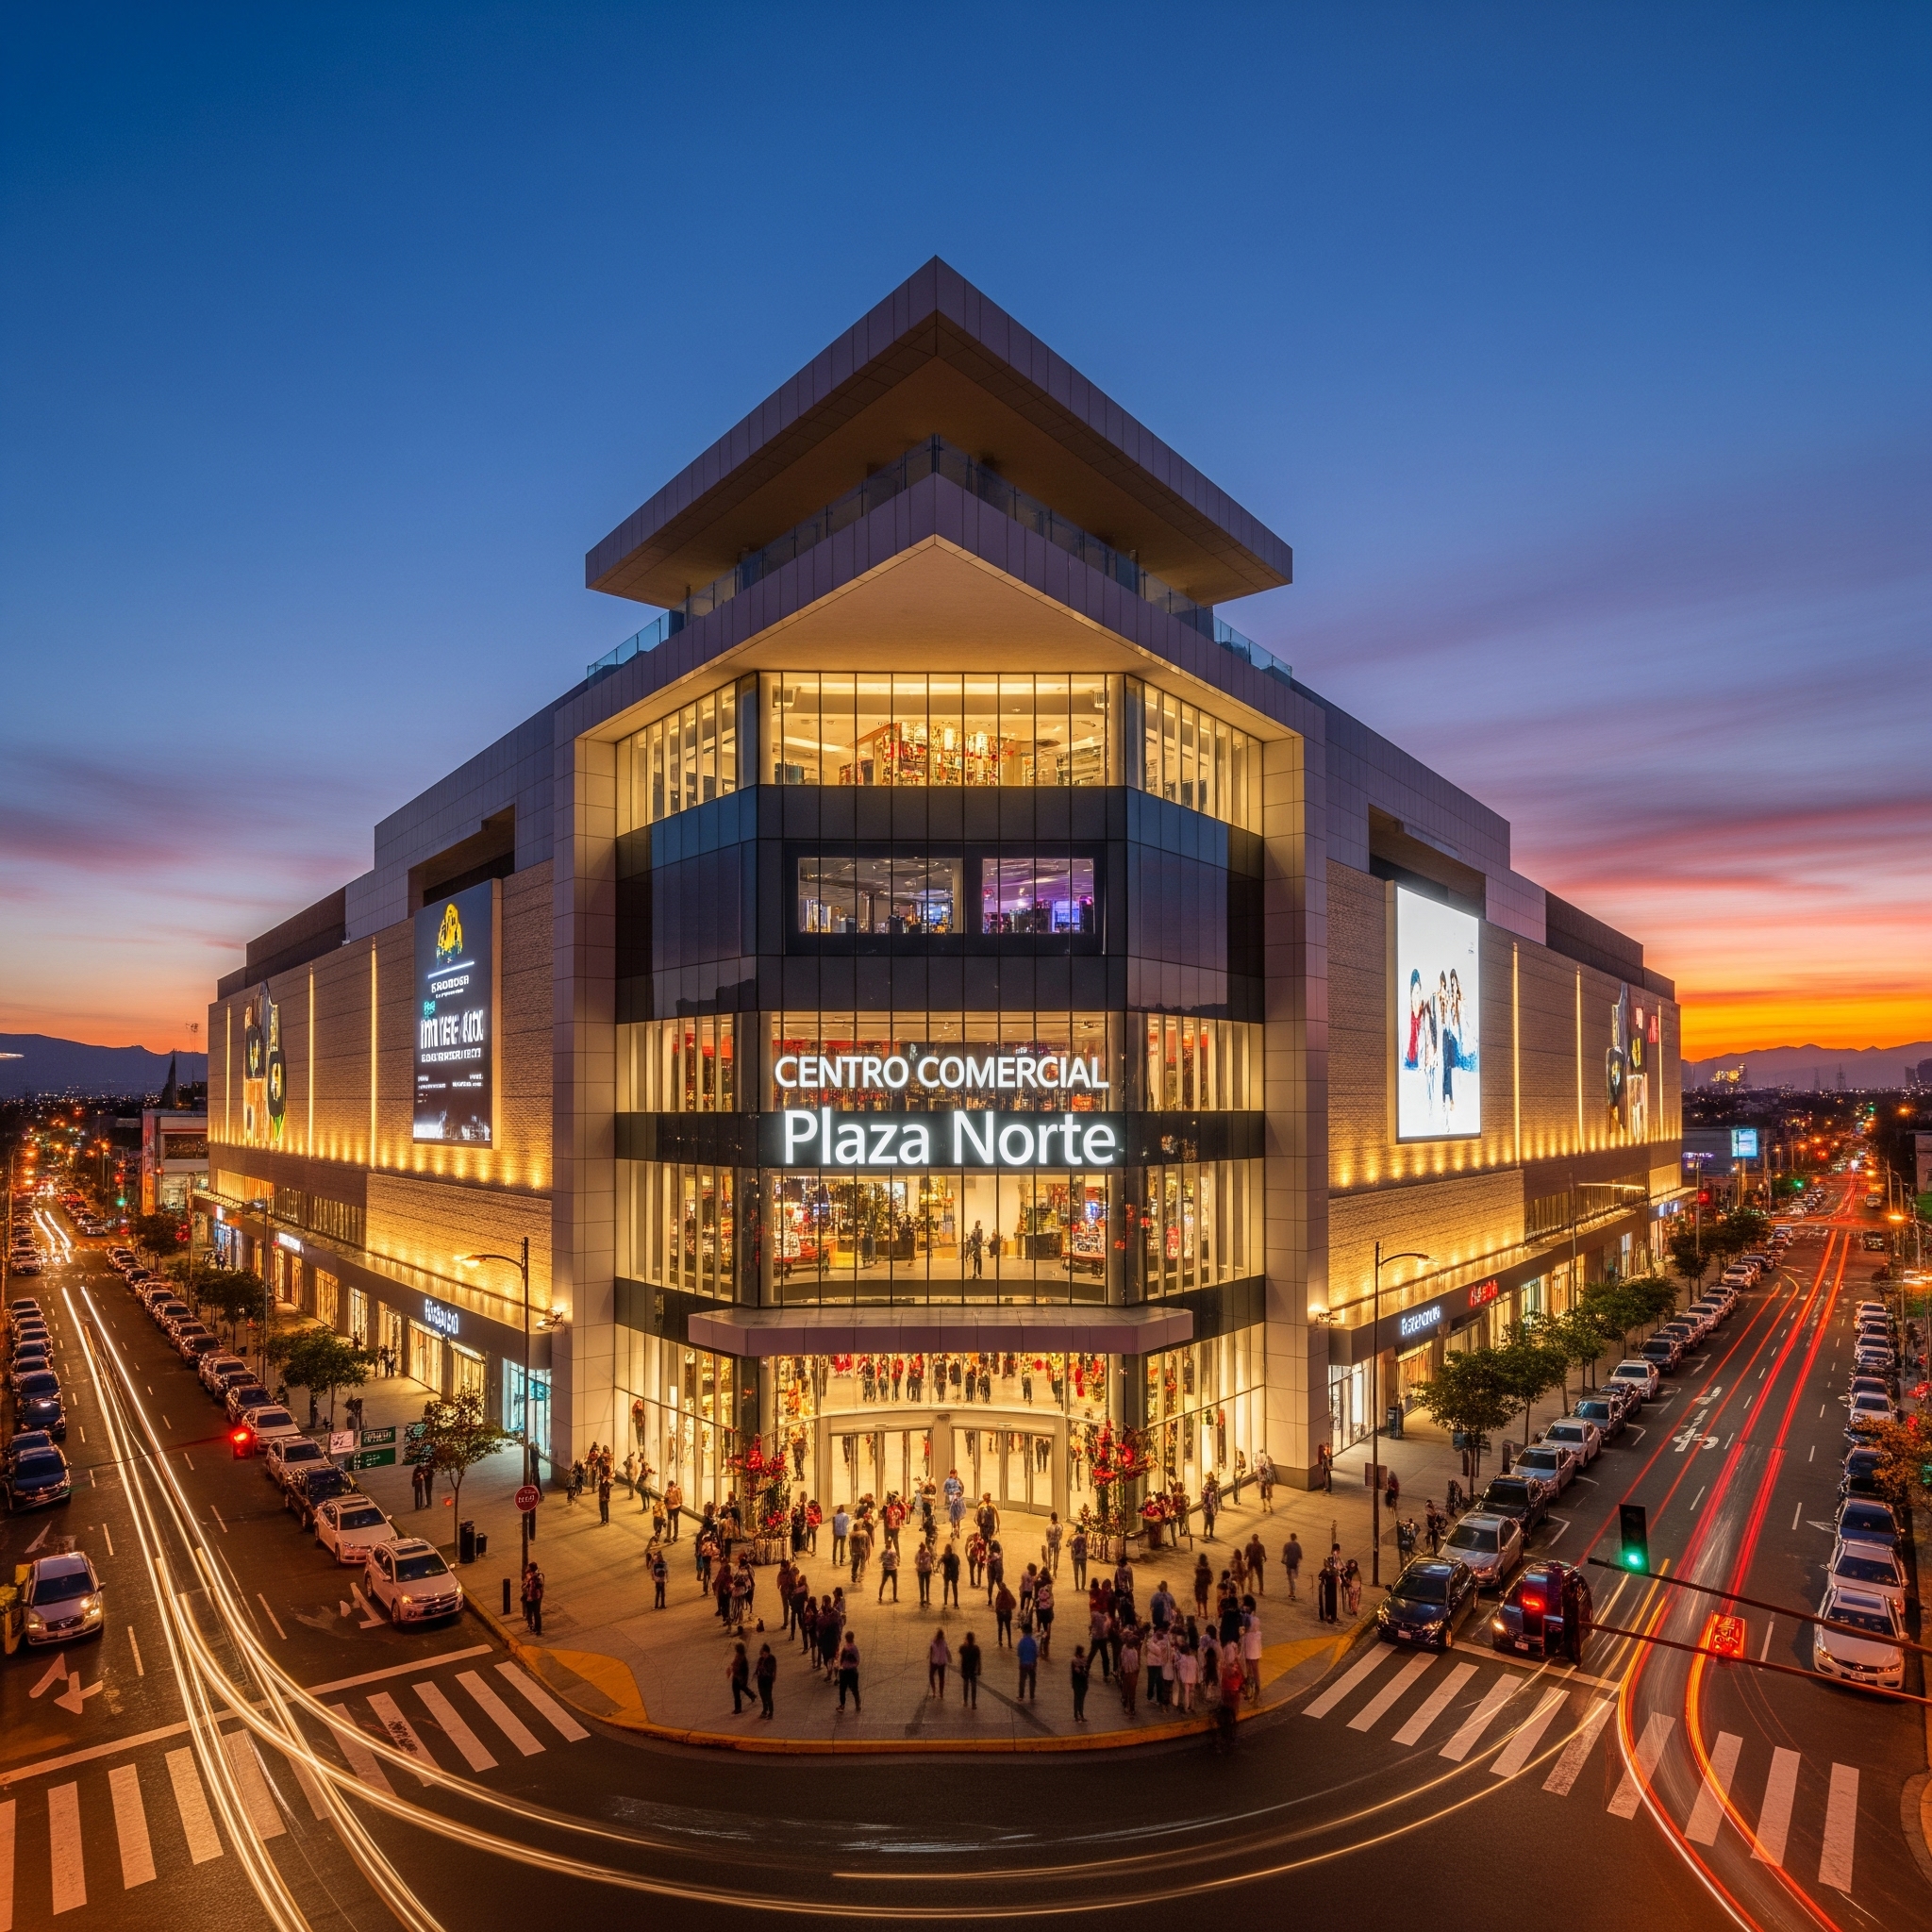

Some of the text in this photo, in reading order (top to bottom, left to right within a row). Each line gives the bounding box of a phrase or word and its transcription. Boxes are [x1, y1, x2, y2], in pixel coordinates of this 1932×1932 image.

[774, 1056, 1109, 1089] CENTRO COMERCIAL
[785, 1107, 1116, 1165] Plaza Norte
